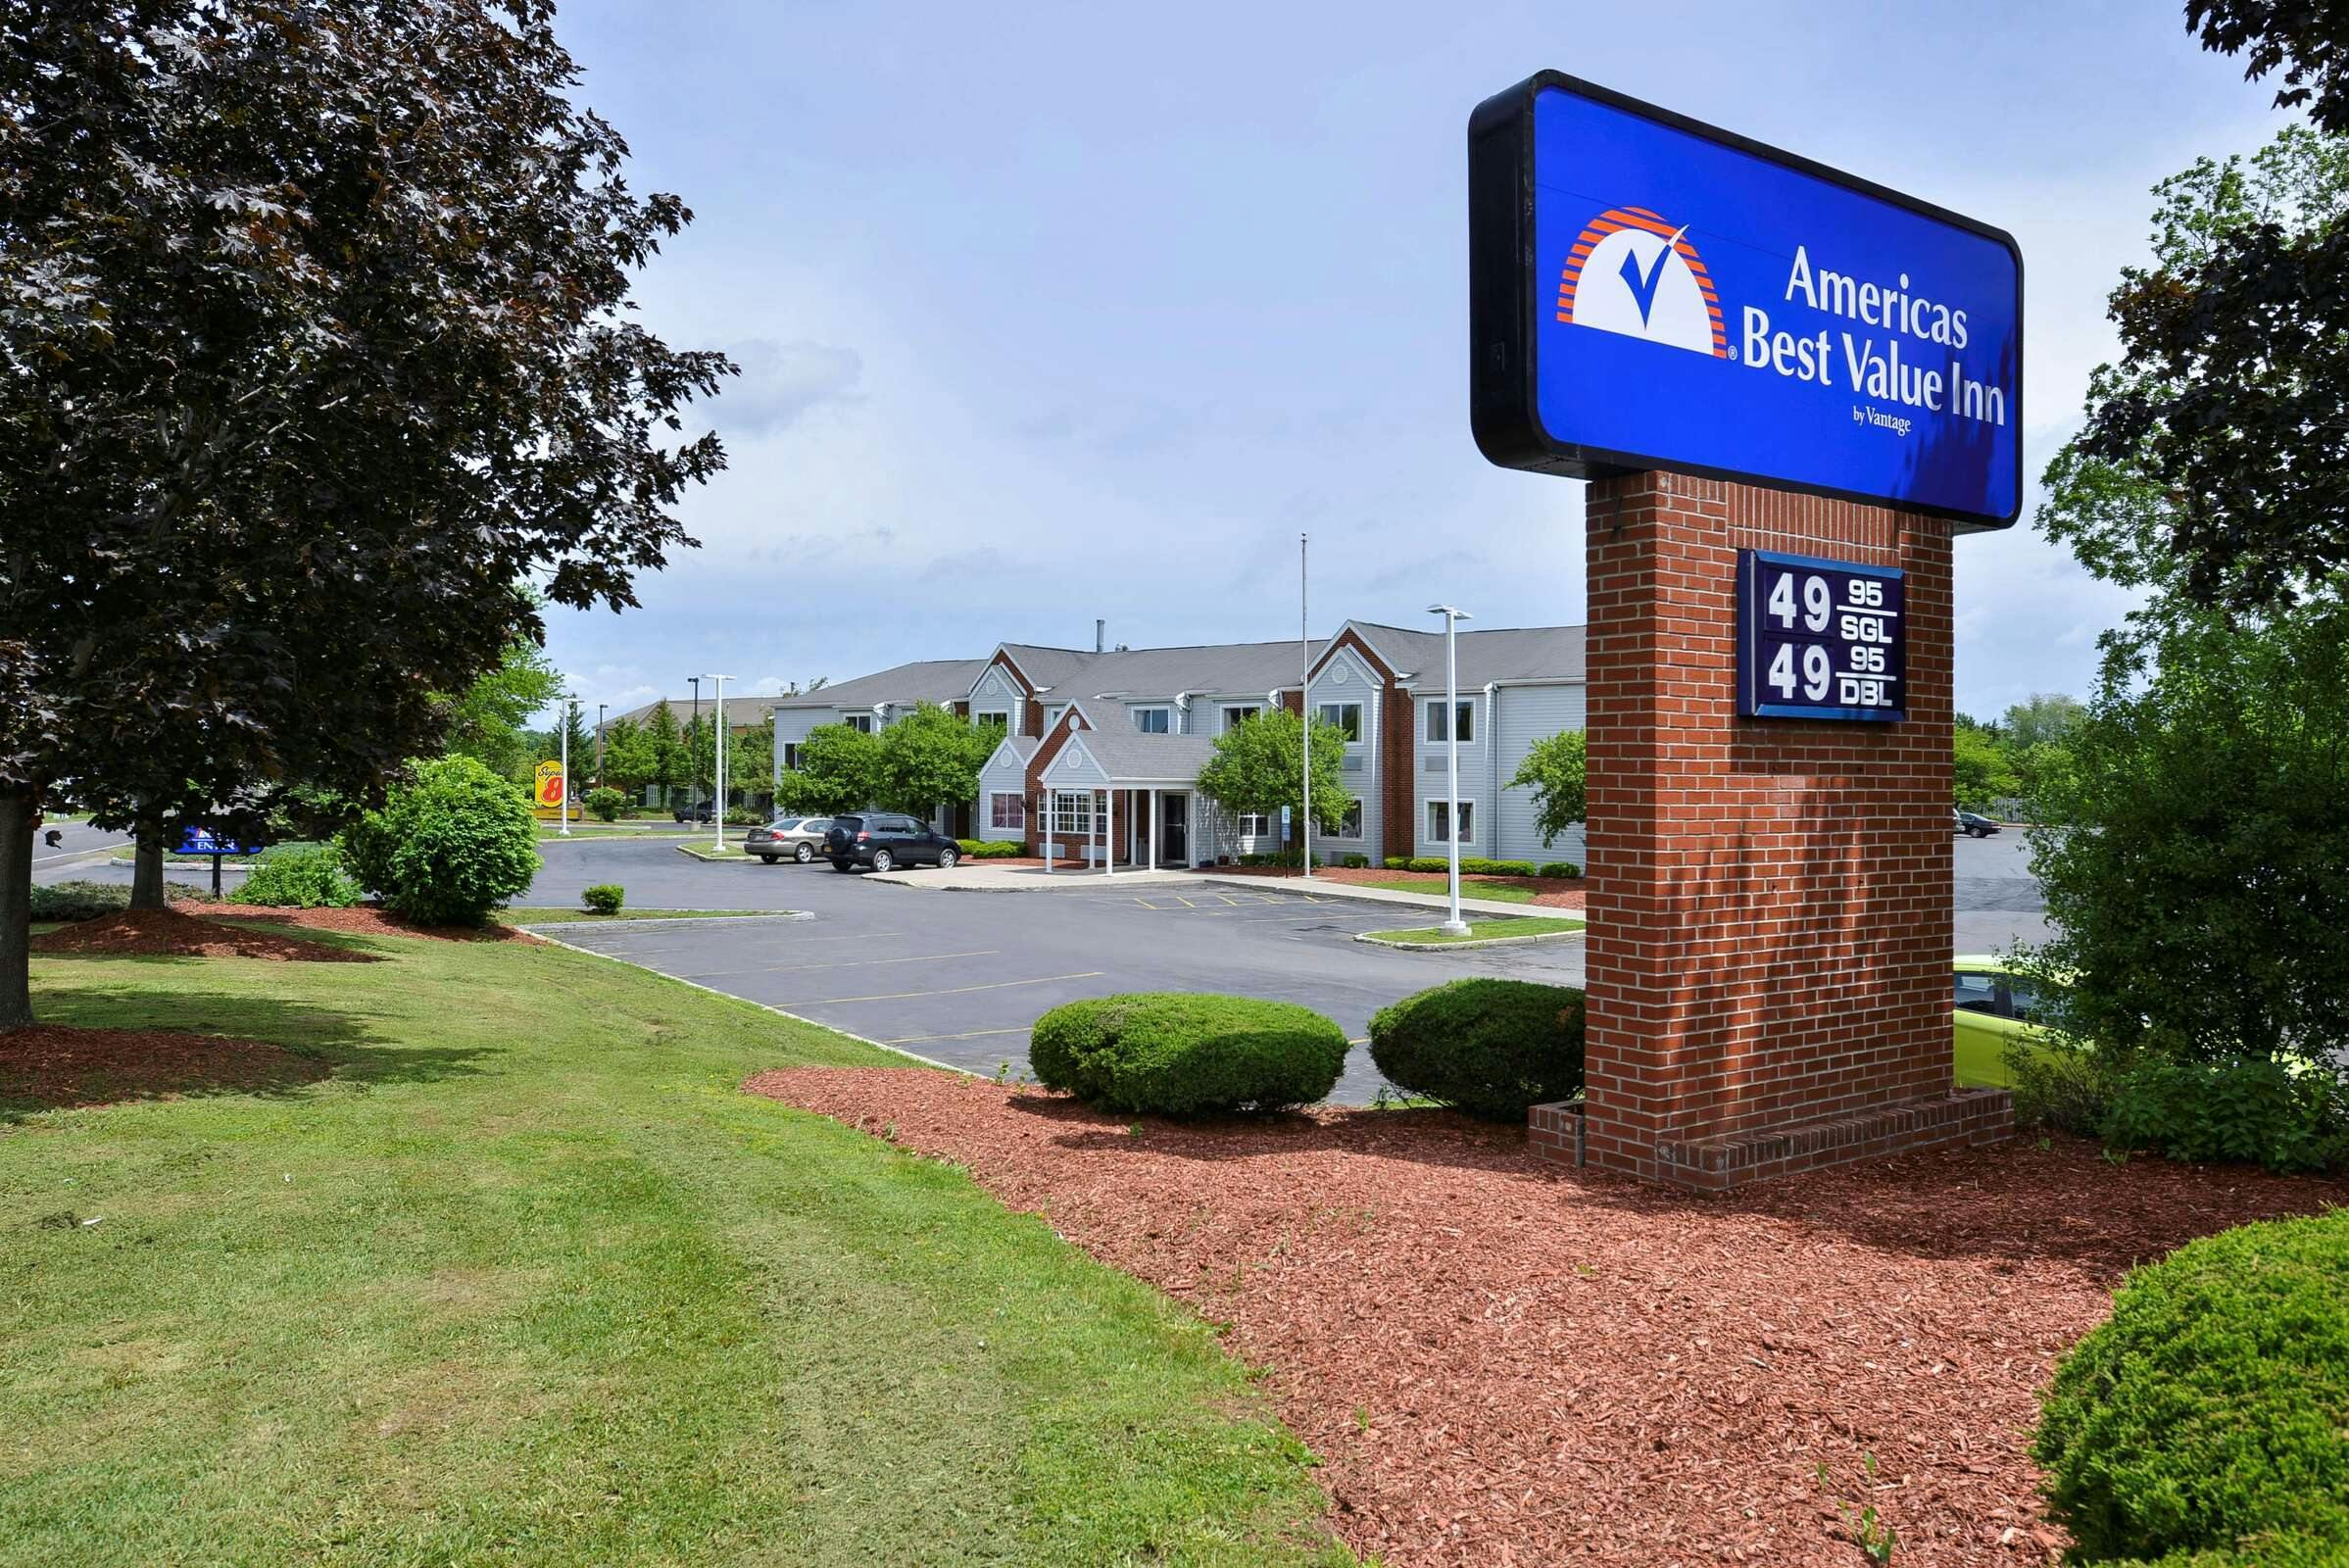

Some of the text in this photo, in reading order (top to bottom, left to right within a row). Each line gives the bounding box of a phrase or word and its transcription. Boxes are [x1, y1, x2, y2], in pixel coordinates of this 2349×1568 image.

[1786, 245, 1968, 349] Americas
[1743, 306, 2005, 425] Best Value Inn
[1853, 406, 1911, 436] by Vantage
[1769, 572, 1883, 632] 49 95
[1840, 614, 1892, 644] SGL
[1768, 643, 1884, 702] 49 95
[1839, 678, 1892, 707] DBL
[538, 766, 563, 782] Supe
[542, 777, 564, 803] 8
[197, 841, 235, 851] ENR
